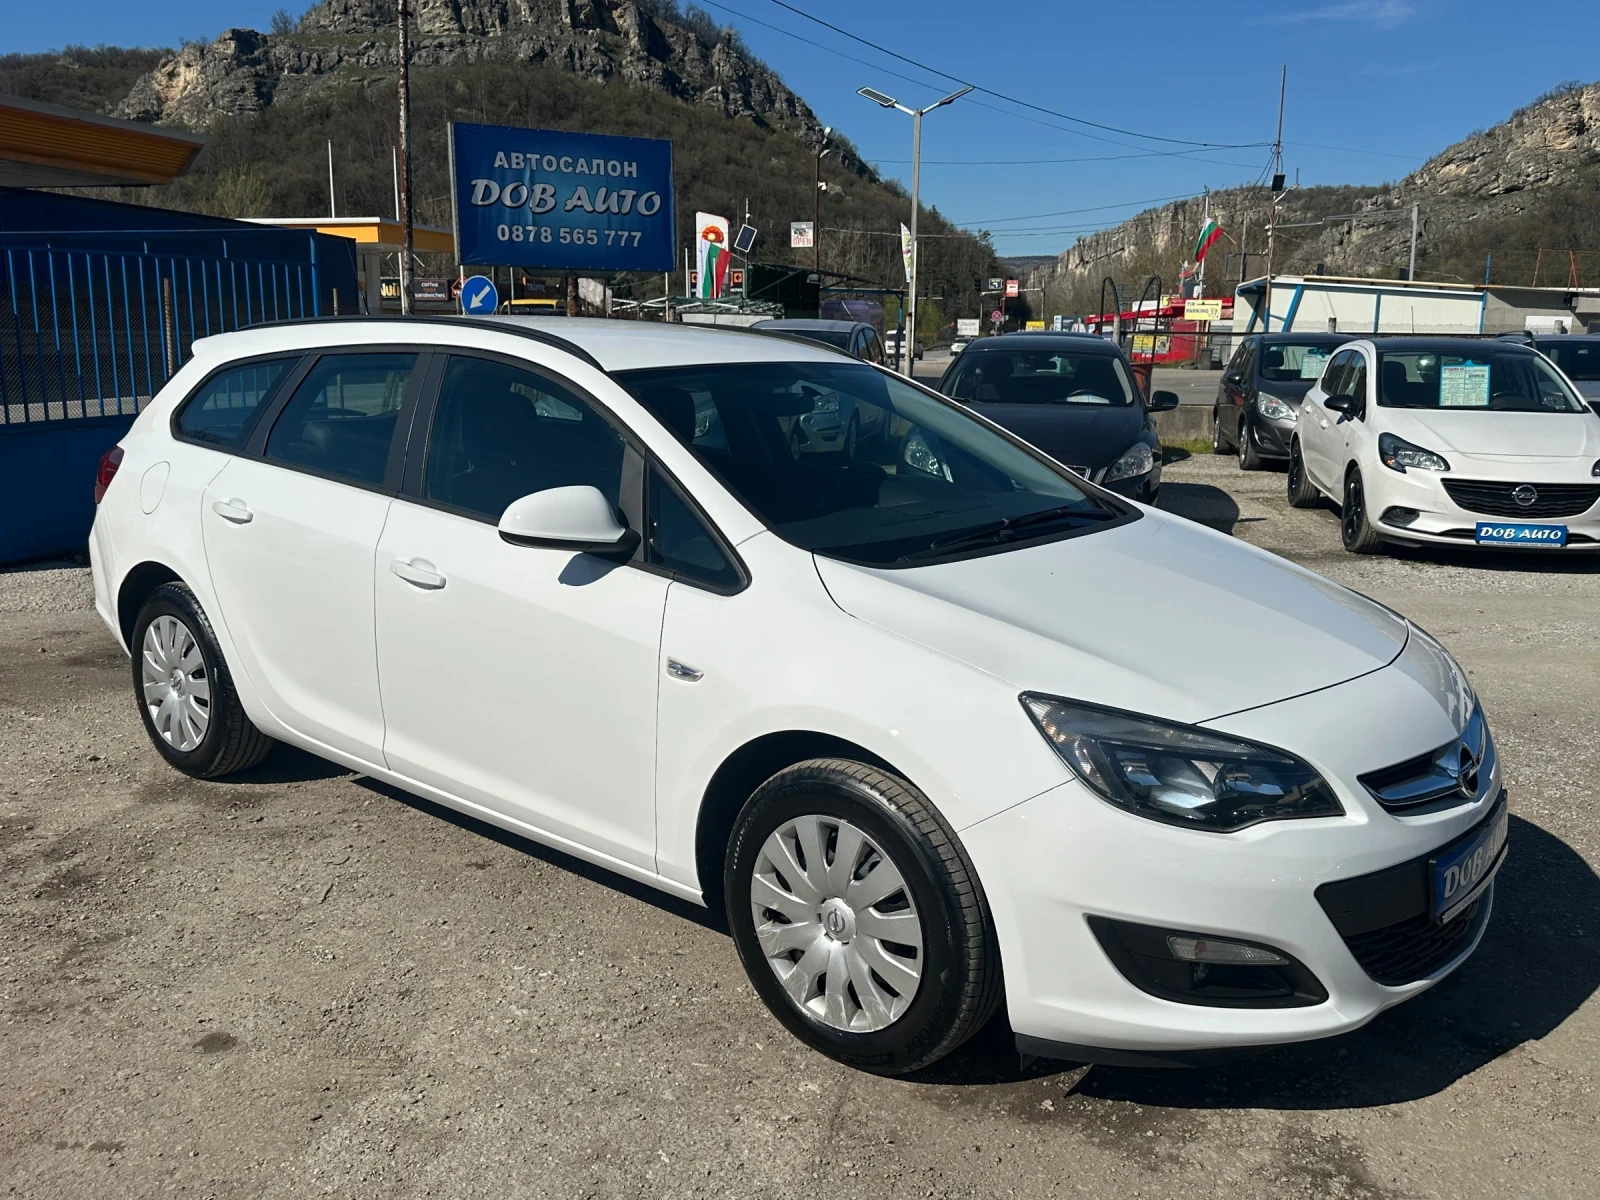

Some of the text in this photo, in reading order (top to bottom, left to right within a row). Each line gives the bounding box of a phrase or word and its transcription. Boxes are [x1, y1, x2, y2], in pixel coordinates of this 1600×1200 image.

[493, 151, 637, 178] АВТОСАЛОН
[470, 179, 661, 216] DOB AUTO
[497, 224, 642, 247] 0878 565 777
[793, 237, 812, 246] OPEN
[1480, 526, 1562, 540] DOB AUTO
[1443, 846, 1484, 899] DOB
